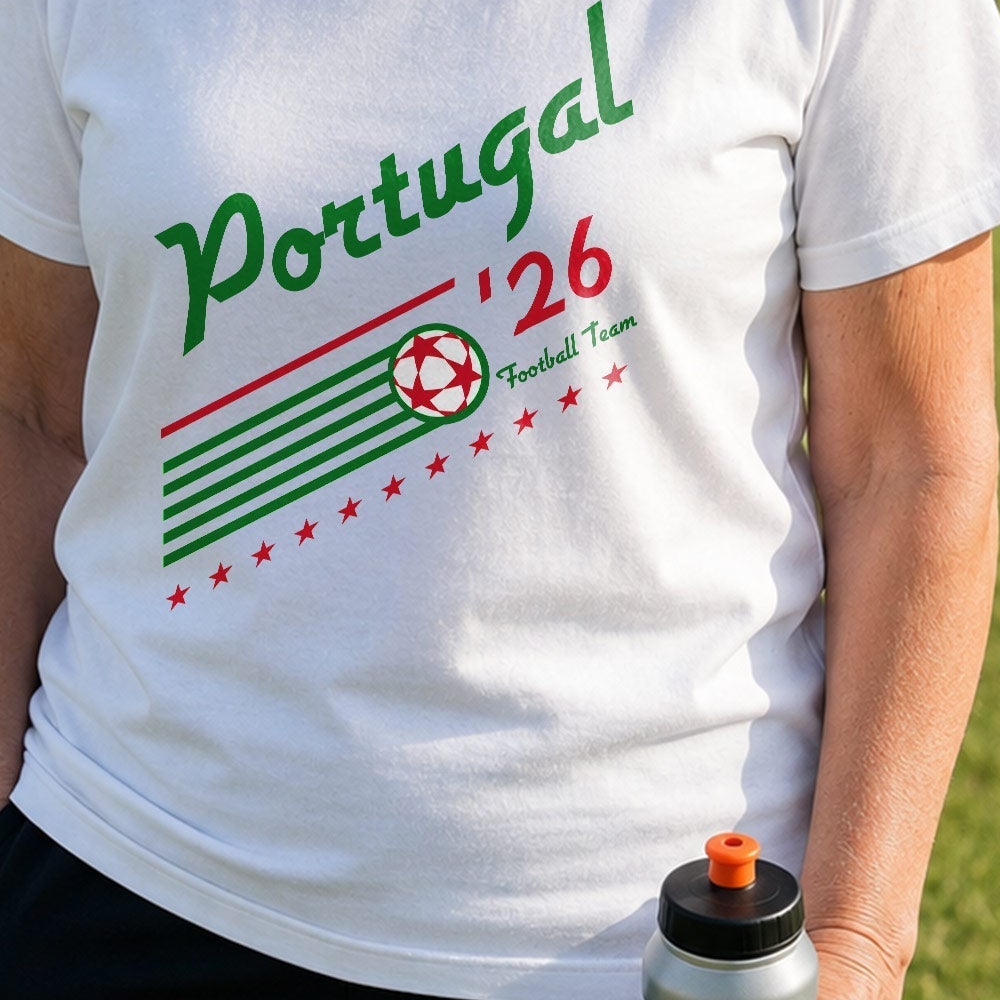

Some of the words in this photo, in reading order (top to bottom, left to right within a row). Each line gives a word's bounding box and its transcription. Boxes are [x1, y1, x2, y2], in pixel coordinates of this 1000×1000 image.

[155, 0, 634, 357] Portugal
[478, 215, 613, 337] '26
[496, 333, 579, 389] Football
[581, 316, 637, 347] Team
